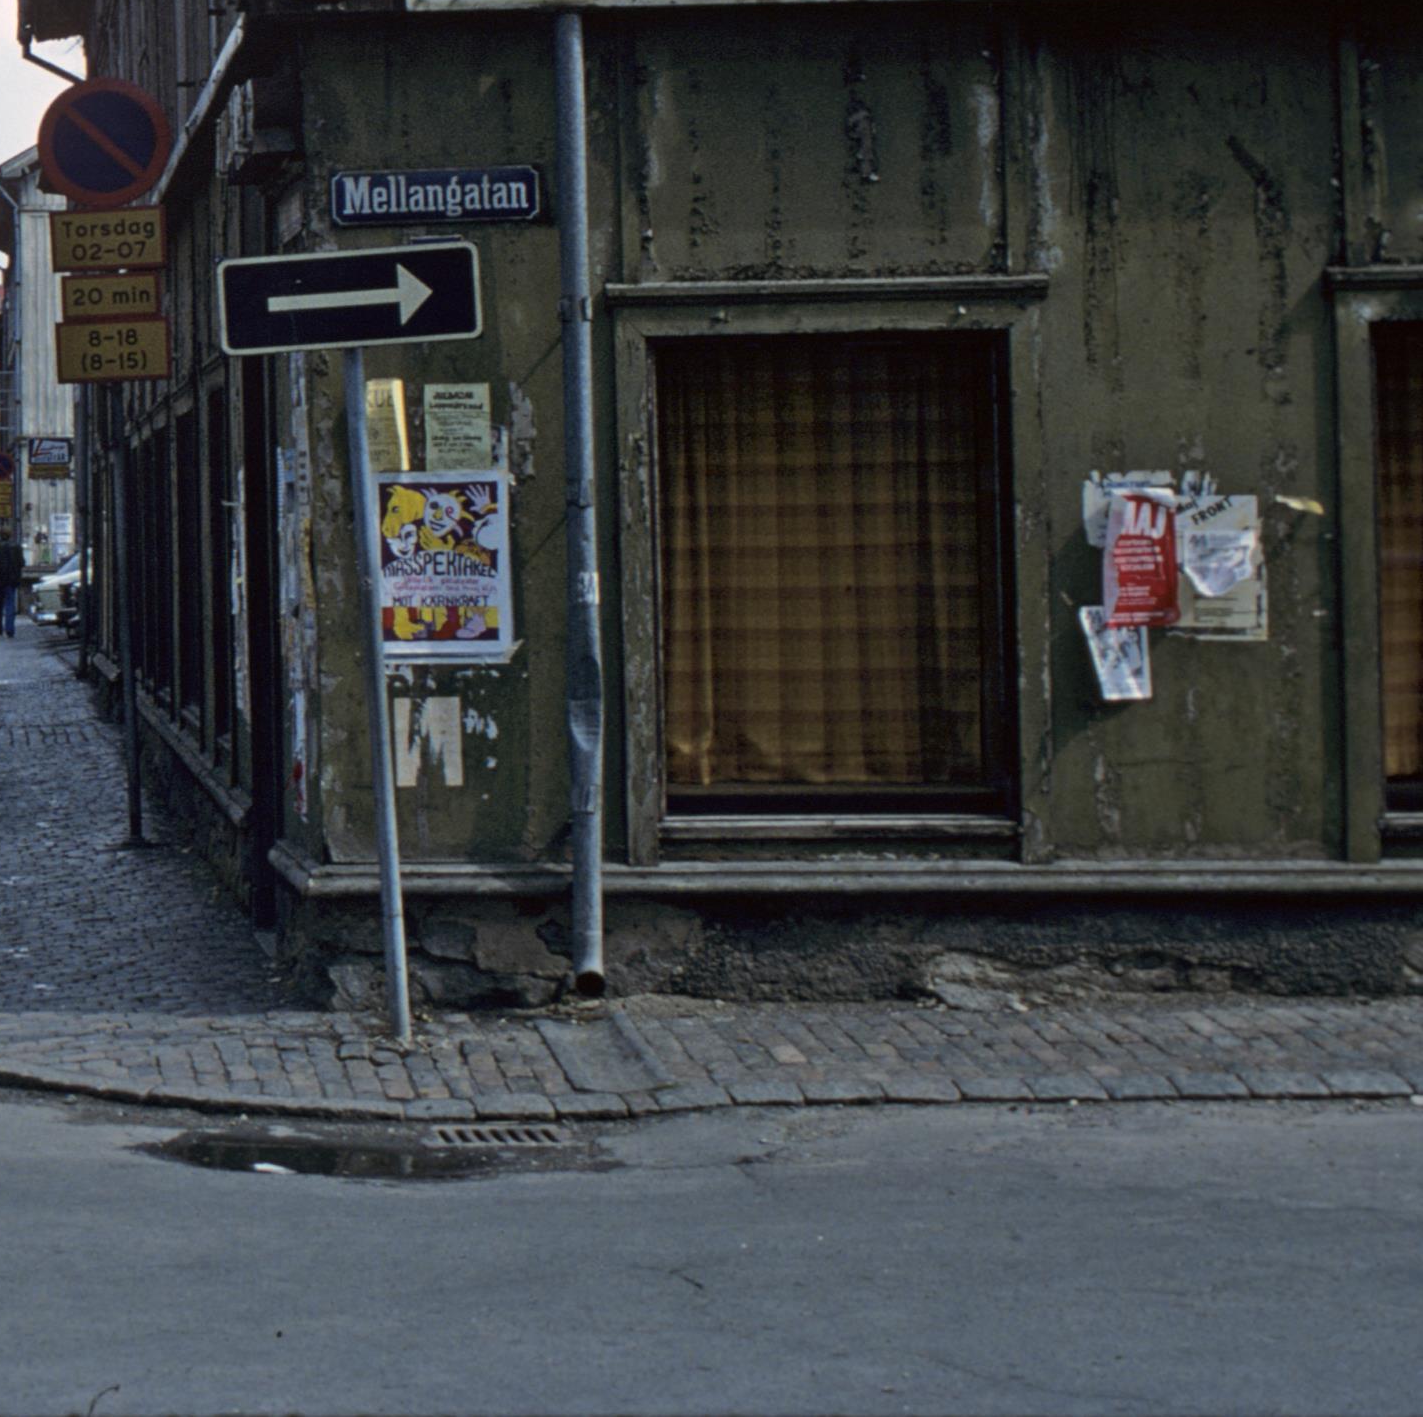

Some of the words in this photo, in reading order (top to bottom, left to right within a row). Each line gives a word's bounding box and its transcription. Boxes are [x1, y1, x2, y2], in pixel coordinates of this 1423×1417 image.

[342, 174, 530, 217] Mellangatan
[61, 218, 156, 239] Torsdag
[71, 240, 147, 262] 02-07
[72, 287, 103, 306] 20
[112, 286, 151, 304] min
[88, 328, 138, 347] 8-18
[80, 349, 147, 373] (8-15)
[1191, 495, 1232, 525] FRONT
[392, 595, 413, 607] MOT
